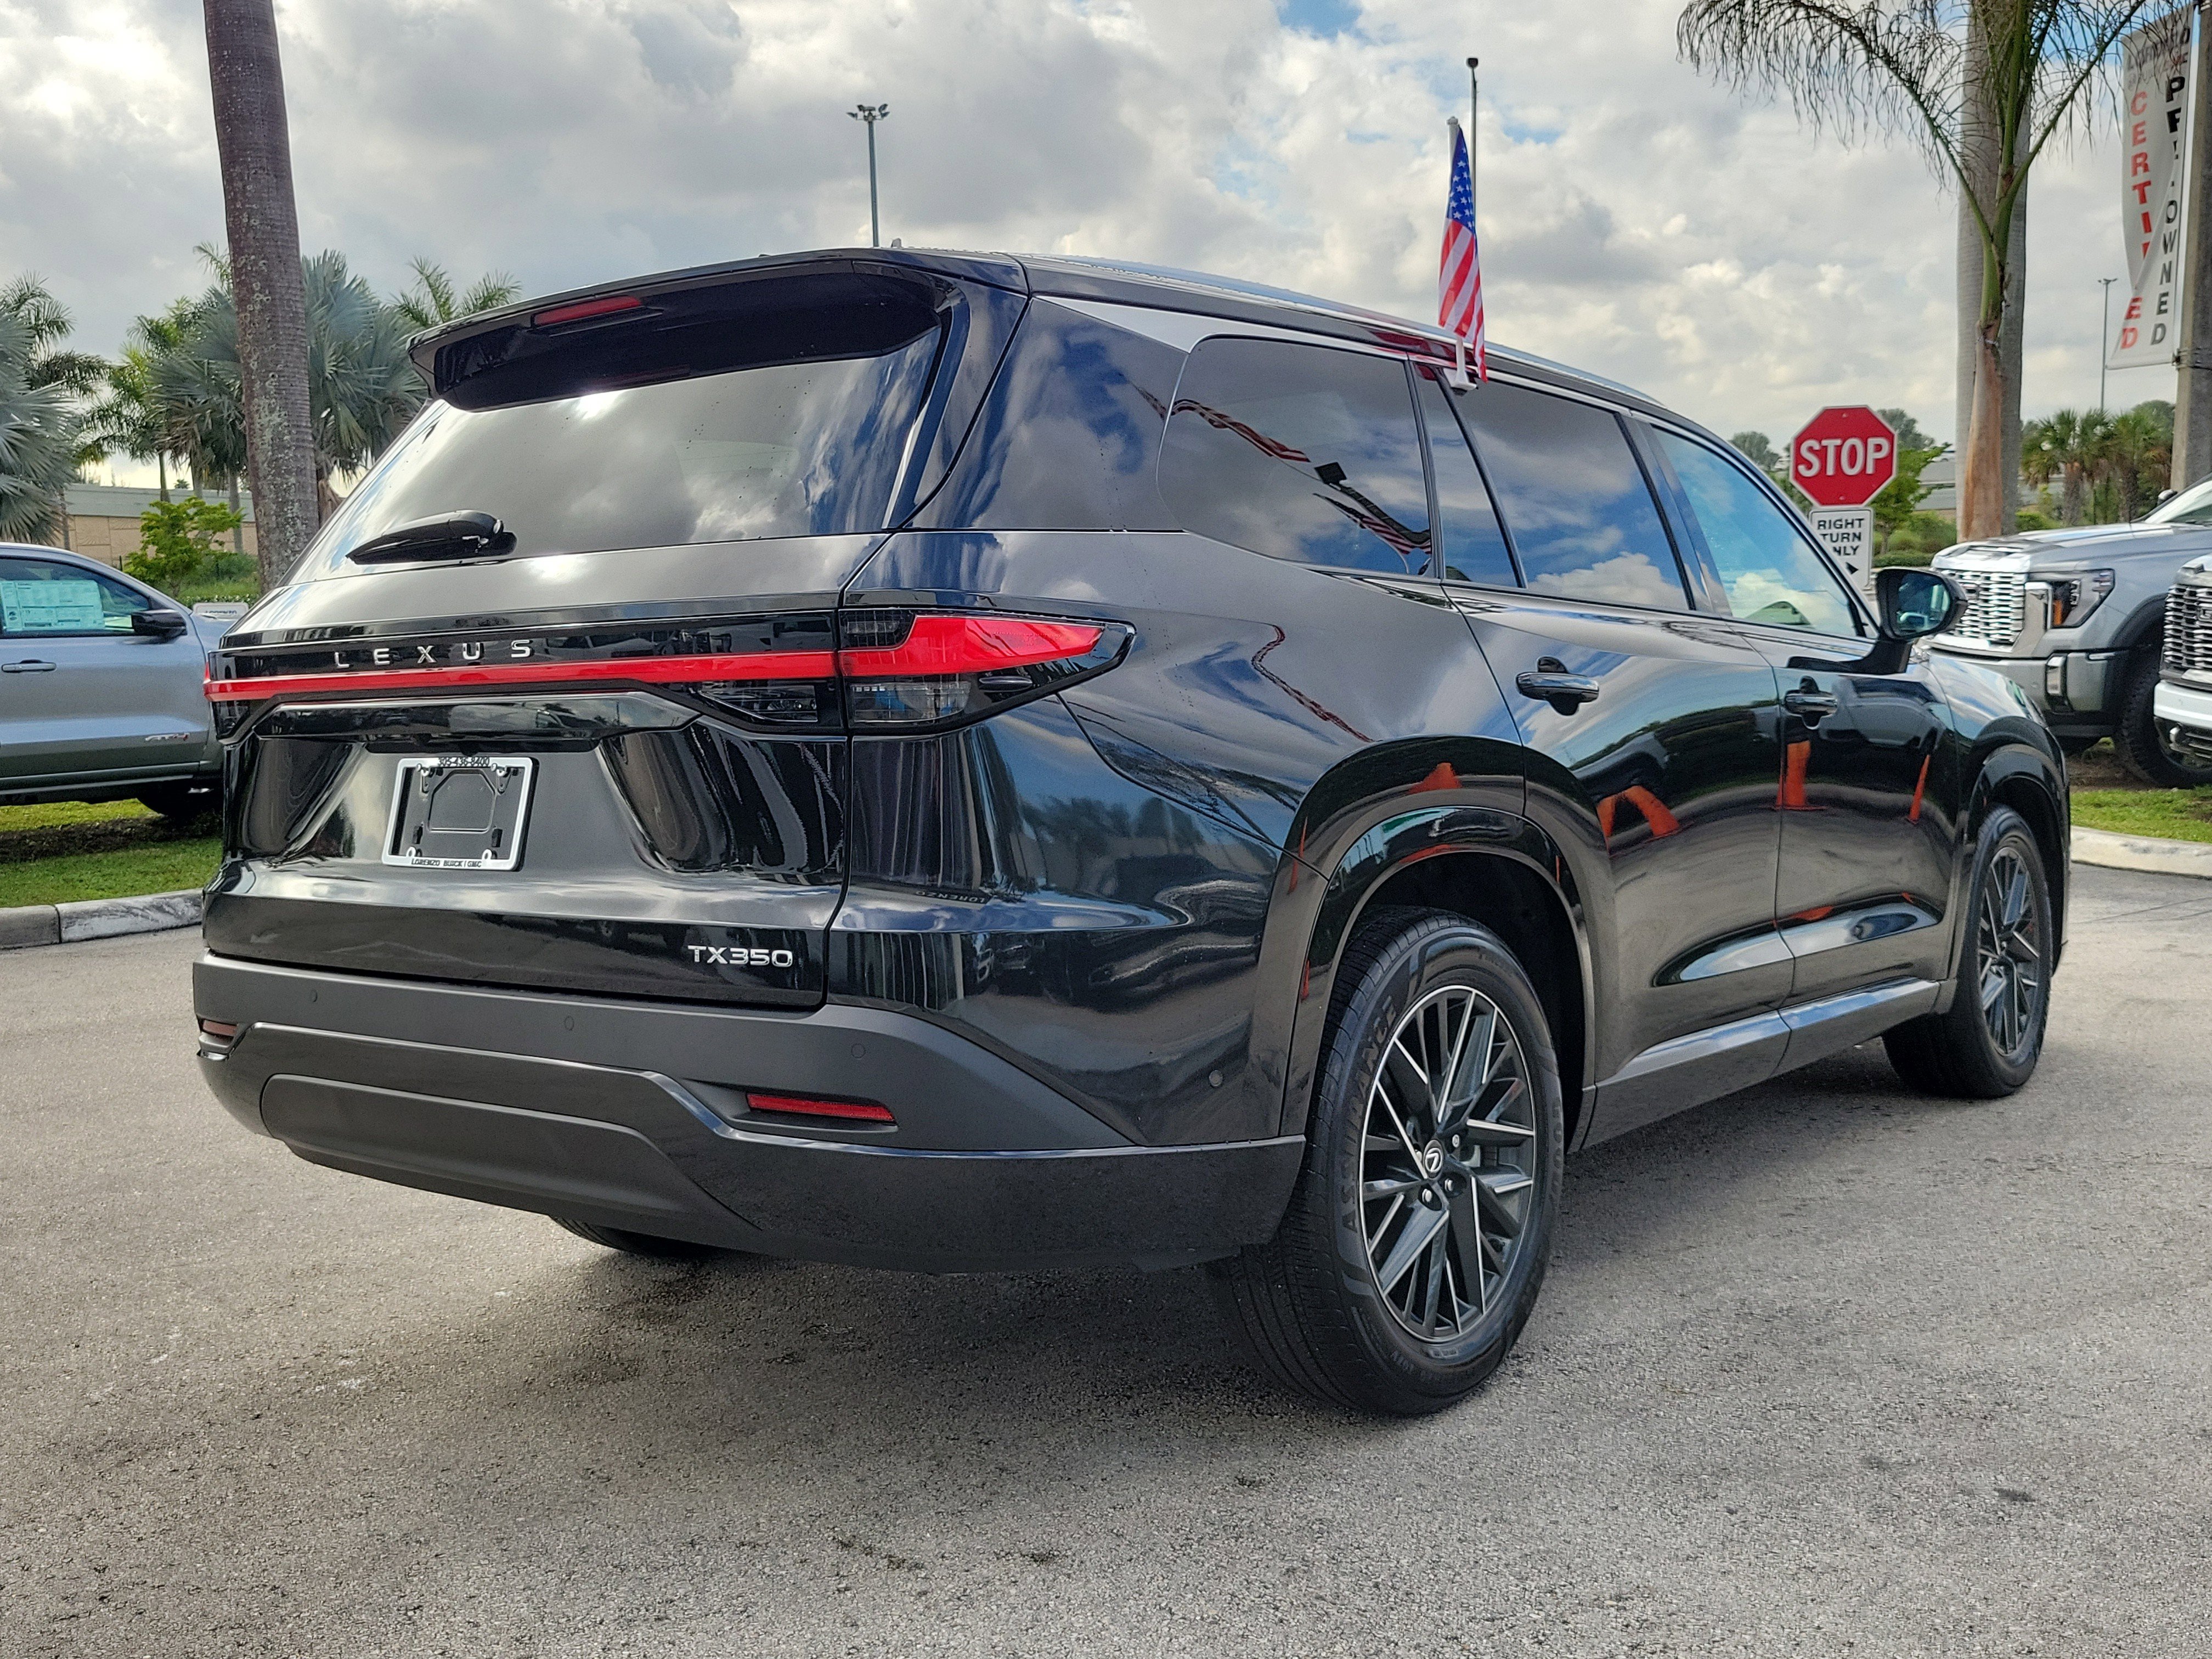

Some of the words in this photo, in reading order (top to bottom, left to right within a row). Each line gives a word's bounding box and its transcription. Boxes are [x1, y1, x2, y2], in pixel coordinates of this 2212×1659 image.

[1797, 437, 1890, 477] STOP
[1817, 518, 1865, 530] RIGHT
[1819, 532, 1861, 543] TURN
[1833, 545, 1860, 556] NLY
[334, 639, 533, 669] LEXUS
[411, 858, 440, 866] LORENZO
[687, 945, 793, 968] TX350
